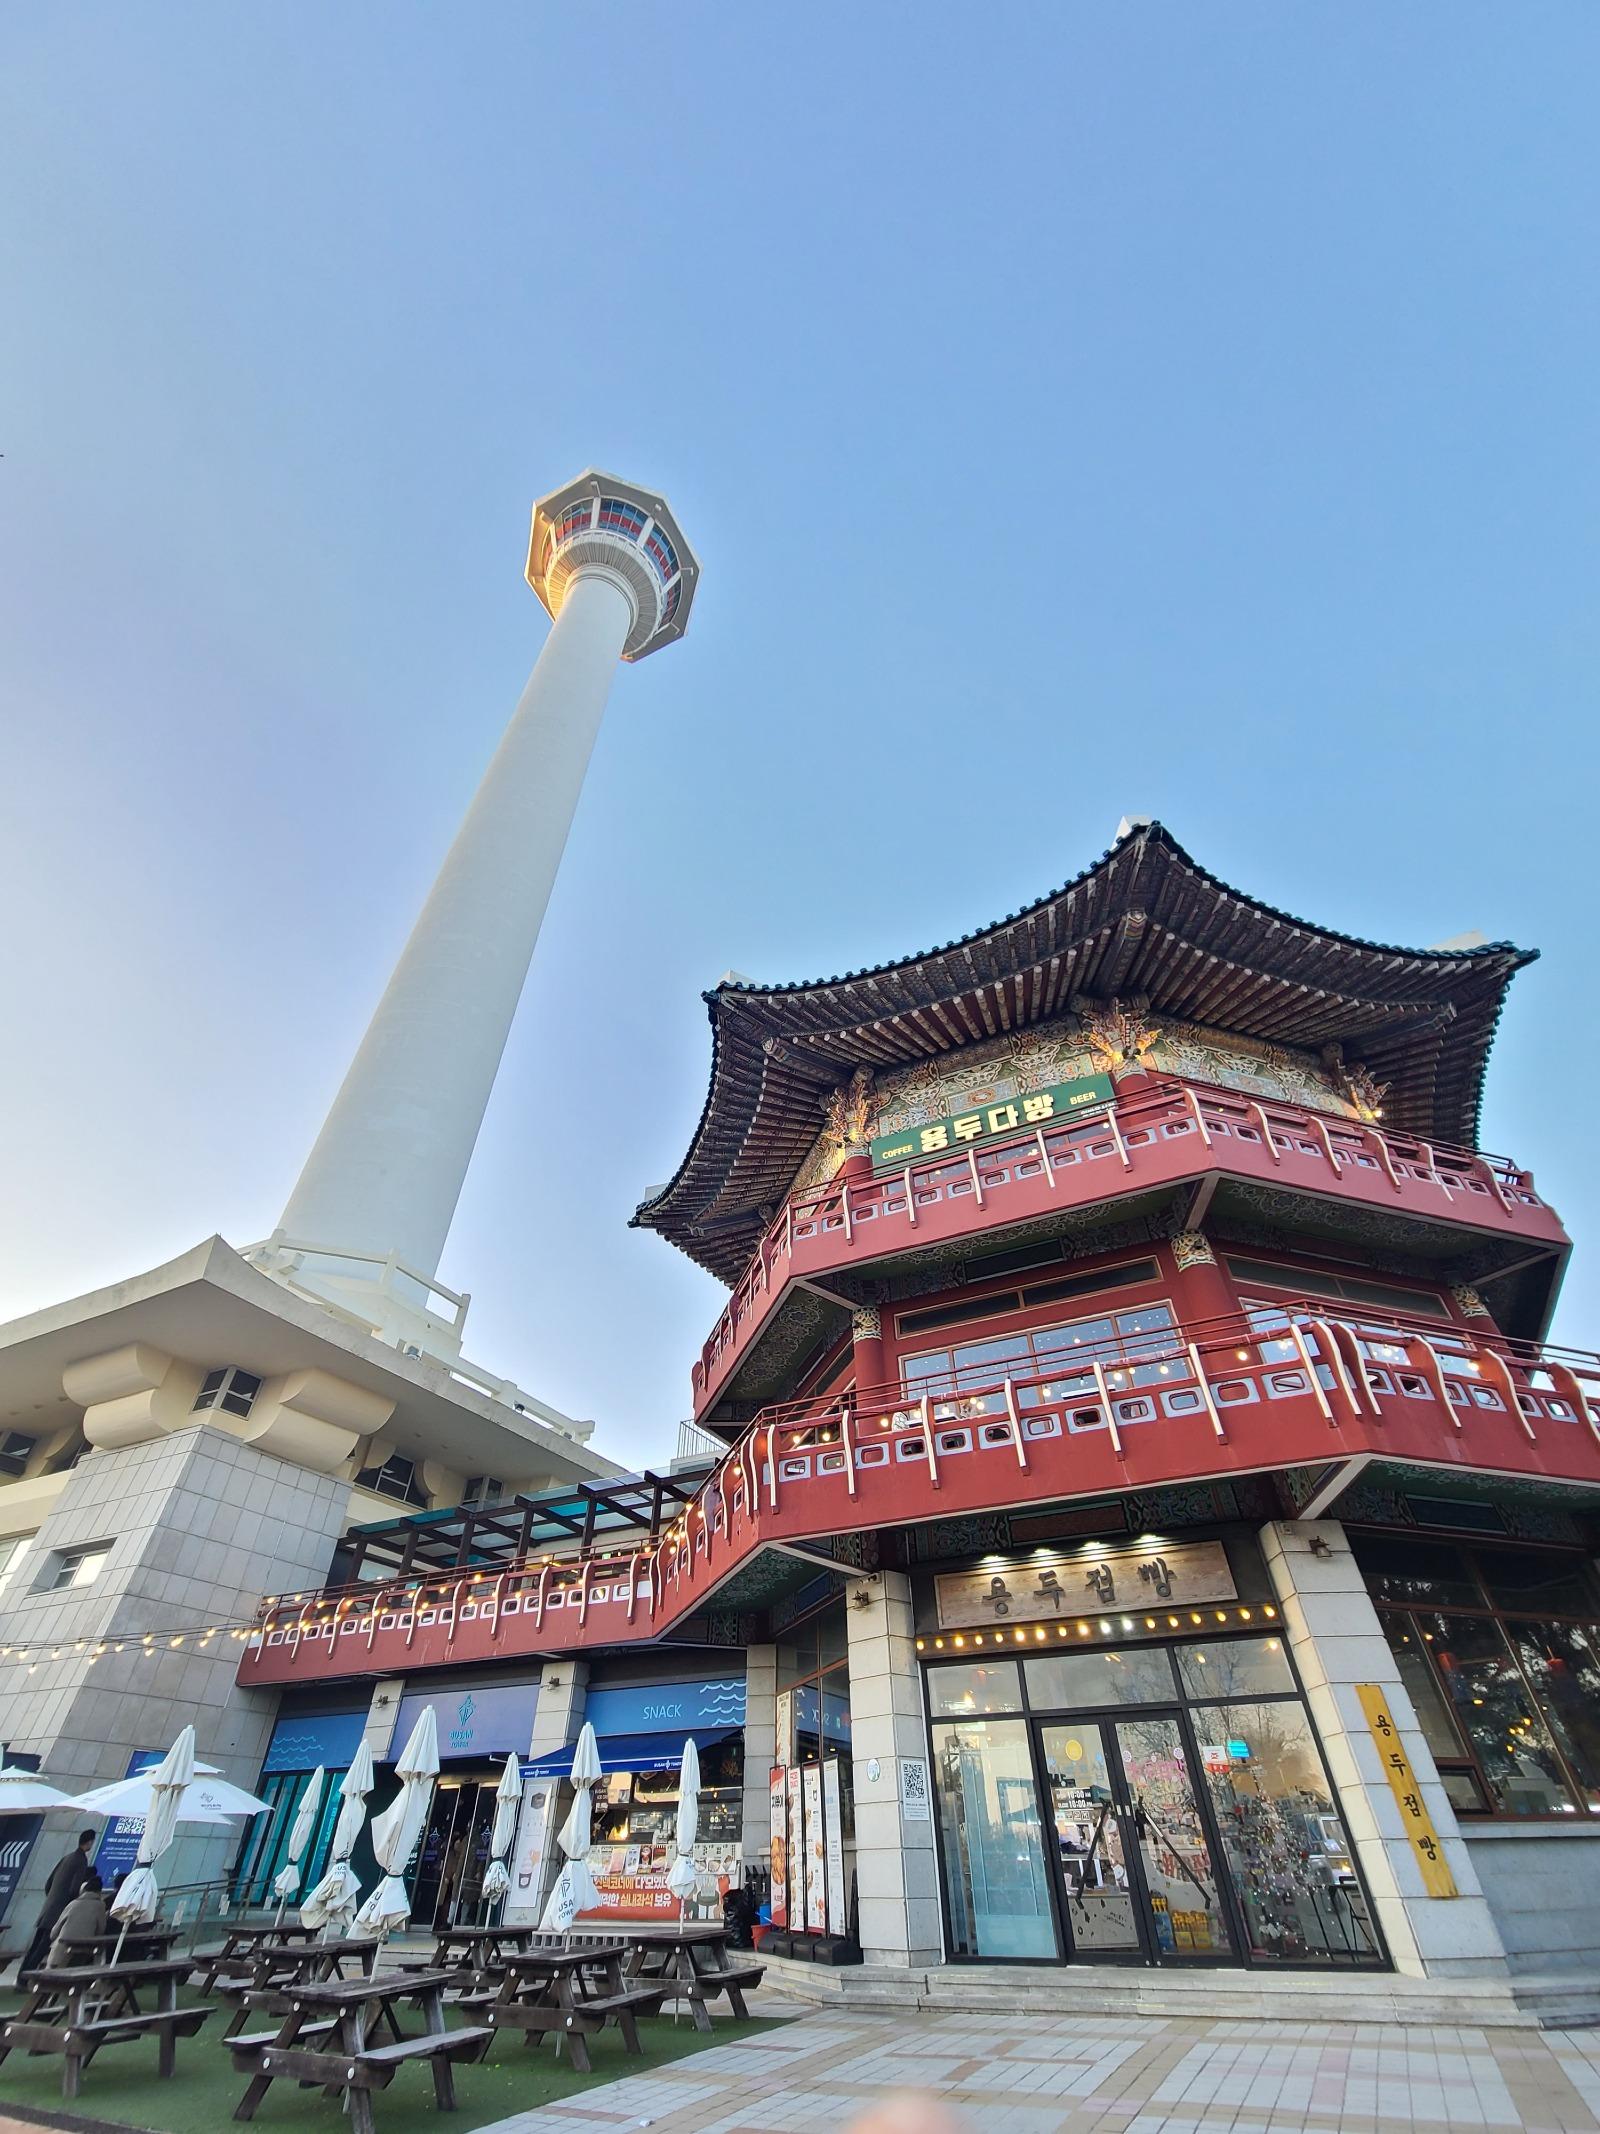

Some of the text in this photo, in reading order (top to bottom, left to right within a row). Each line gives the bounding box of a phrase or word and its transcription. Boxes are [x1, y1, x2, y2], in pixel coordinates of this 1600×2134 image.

[1069, 1091, 1098, 1106] BEER
[920, 1094, 1054, 1153] 용두다방
[882, 1144, 914, 1160] COFFEE
[982, 1556, 1178, 1617] 용두점빵
[643, 1703, 682, 1720] SNACK
[449, 1729, 474, 1740] BUSAN
[1374, 1714, 1437, 1862] 용두점빵
[654, 1892, 672, 1907] 보유
